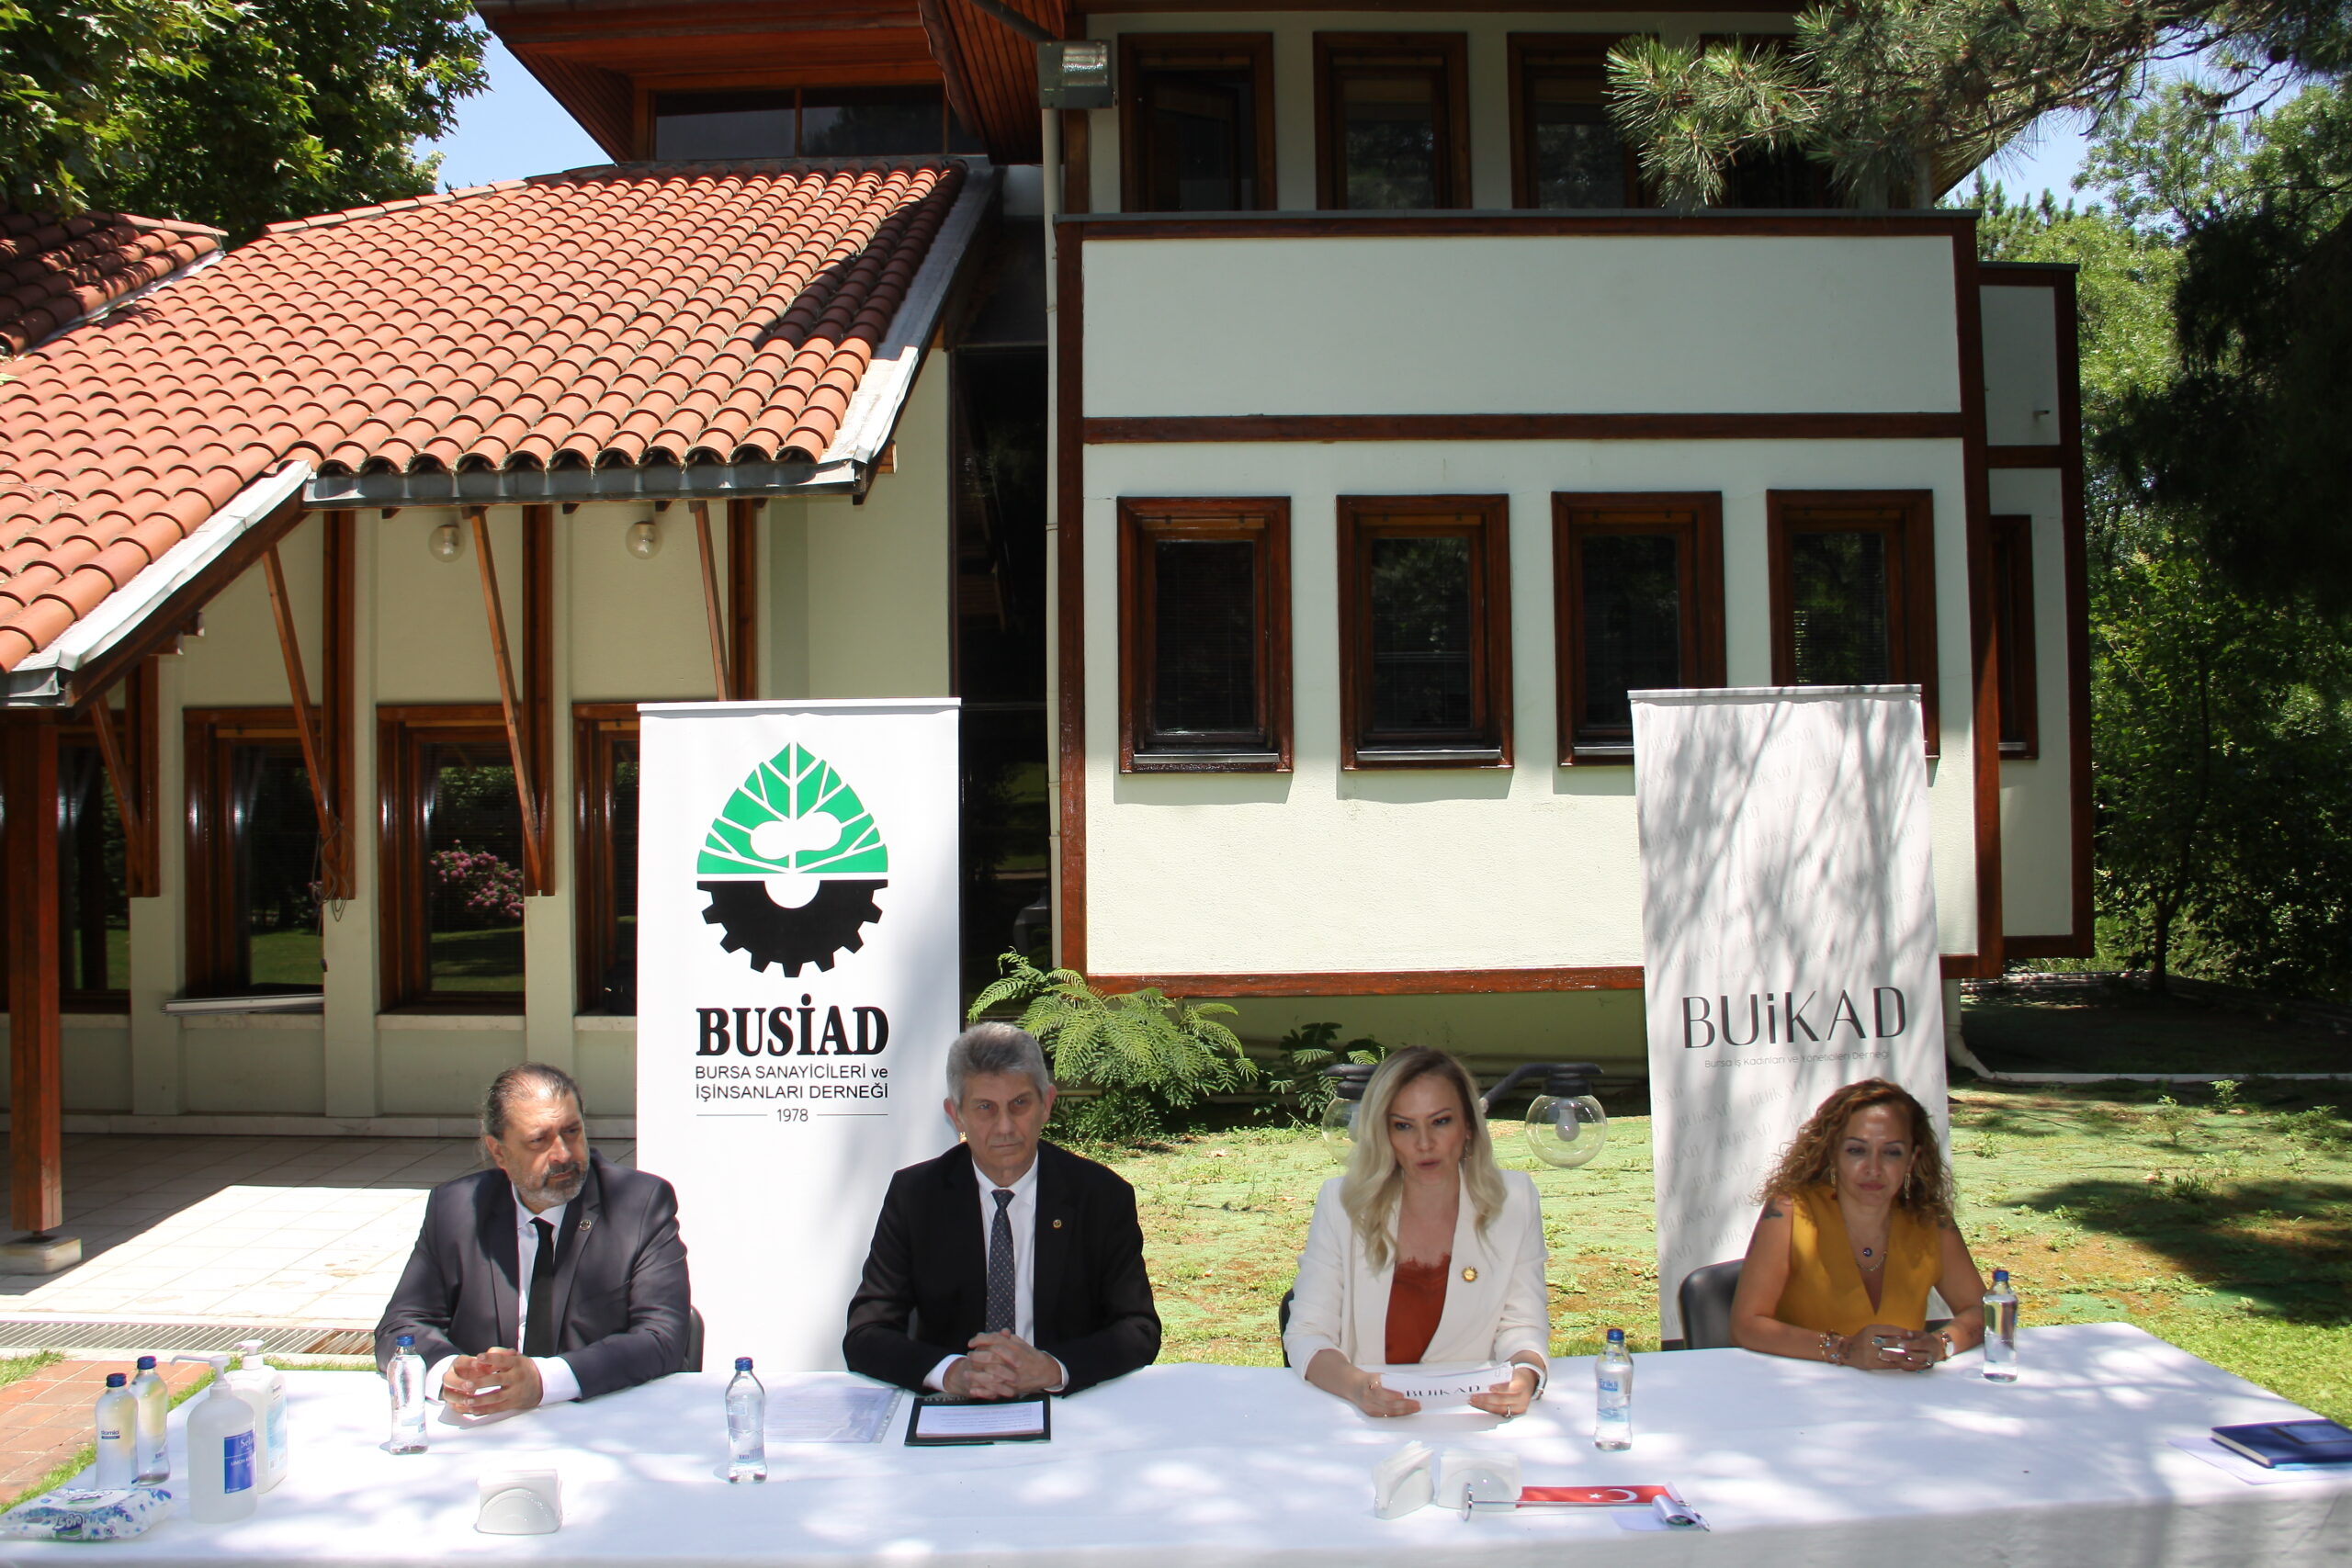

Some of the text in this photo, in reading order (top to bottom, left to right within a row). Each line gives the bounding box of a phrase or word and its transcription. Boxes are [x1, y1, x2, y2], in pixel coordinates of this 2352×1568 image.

[695, 993, 889, 1057] BUSİAD
[1704, 1059, 1733, 1068] Bursa
[1743, 1055, 1786, 1066] Kadınları
[1788, 1055, 1799, 1064] ve
[695, 1064, 888, 1078] BURSA SANAYİCİLERİ ve
[695, 1083, 888, 1102] İŞİNSANLARI DERNEĞİ
[776, 1109, 808, 1122] 1978
